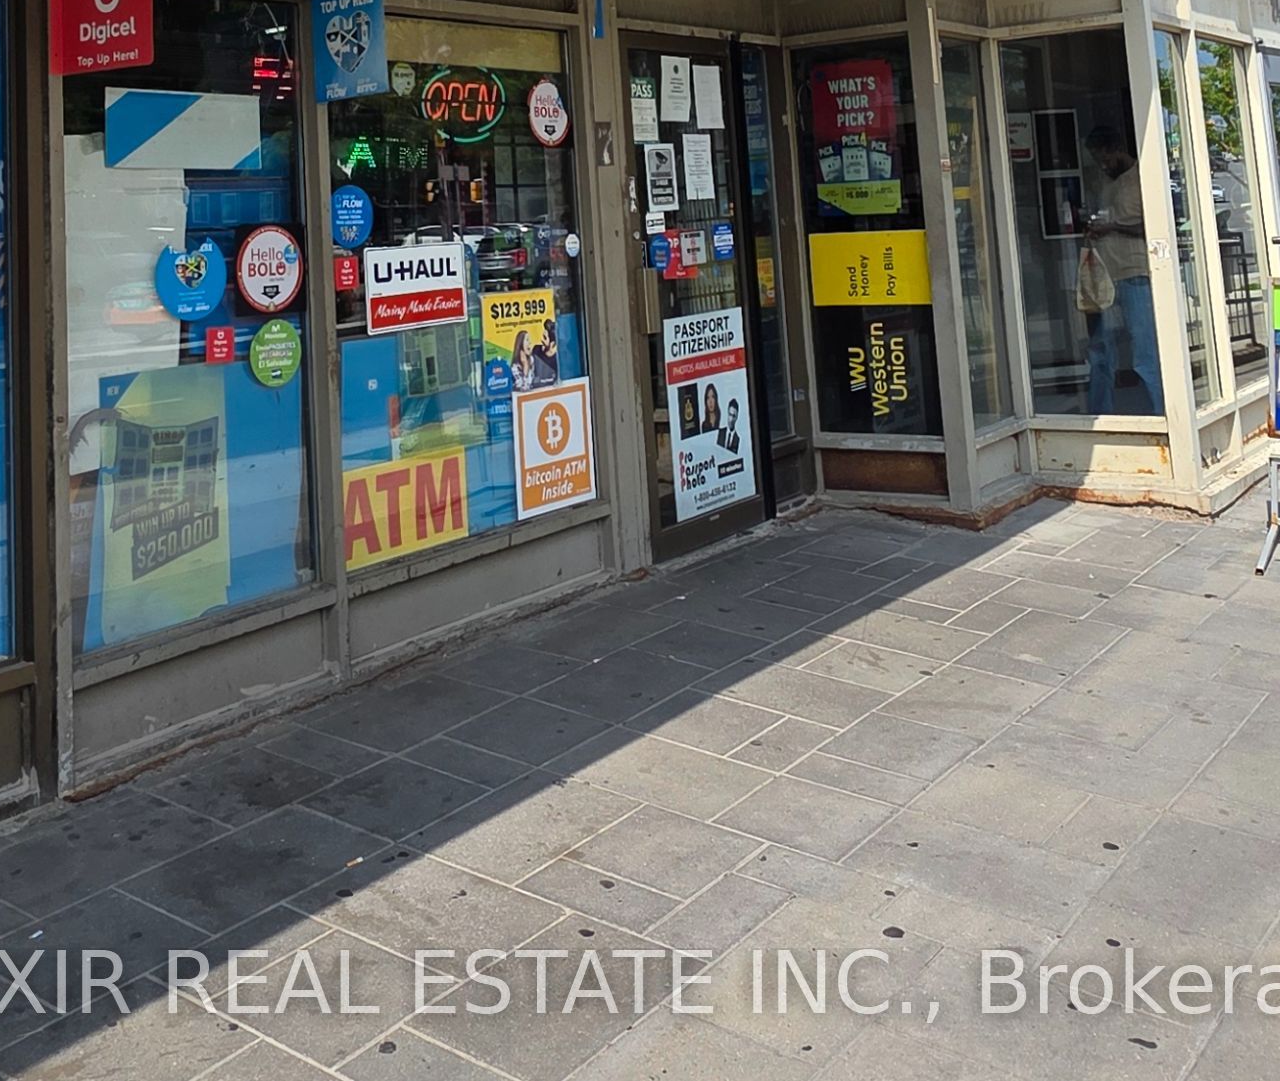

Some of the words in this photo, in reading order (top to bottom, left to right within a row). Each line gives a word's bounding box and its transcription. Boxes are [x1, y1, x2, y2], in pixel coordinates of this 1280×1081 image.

[320, 0, 337, 15] TOP
[78, 16, 137, 44] Digicel
[77, 56, 94, 68] Top
[97, 53, 110, 65] Up
[113, 48, 139, 62] Here!
[631, 84, 653, 99] PASS
[827, 76, 876, 94] WHAT'S
[426, 81, 497, 121] OPEN
[535, 94, 560, 107] Hello
[836, 94, 869, 111] YOUR
[837, 111, 875, 127] PICK?
[342, 199, 364, 208] FLOW
[251, 247, 284, 261] Hello
[883, 246, 893, 270] Bills
[248, 261, 286, 277] BOLO
[373, 257, 457, 283] U-HAUL
[861, 254, 869, 296] Money
[848, 266, 858, 297] Send
[886, 275, 897, 296] Pay
[375, 304, 407, 320] Moving
[407, 298, 433, 317] Made
[490, 298, 546, 320] $123,999
[674, 315, 730, 339] PASSPORT
[671, 331, 735, 358] CITIZENSHIP
[848, 347, 866, 385] WU
[870, 321, 890, 417] Western
[887, 336, 908, 402] Union
[679, 451, 693, 465] Pro
[680, 455, 716, 479] Passport
[525, 468, 562, 489] bitcoin
[563, 459, 587, 478] ATM
[681, 474, 706, 493] Photo
[542, 481, 574, 502] Inside
[344, 456, 464, 562] ATM
